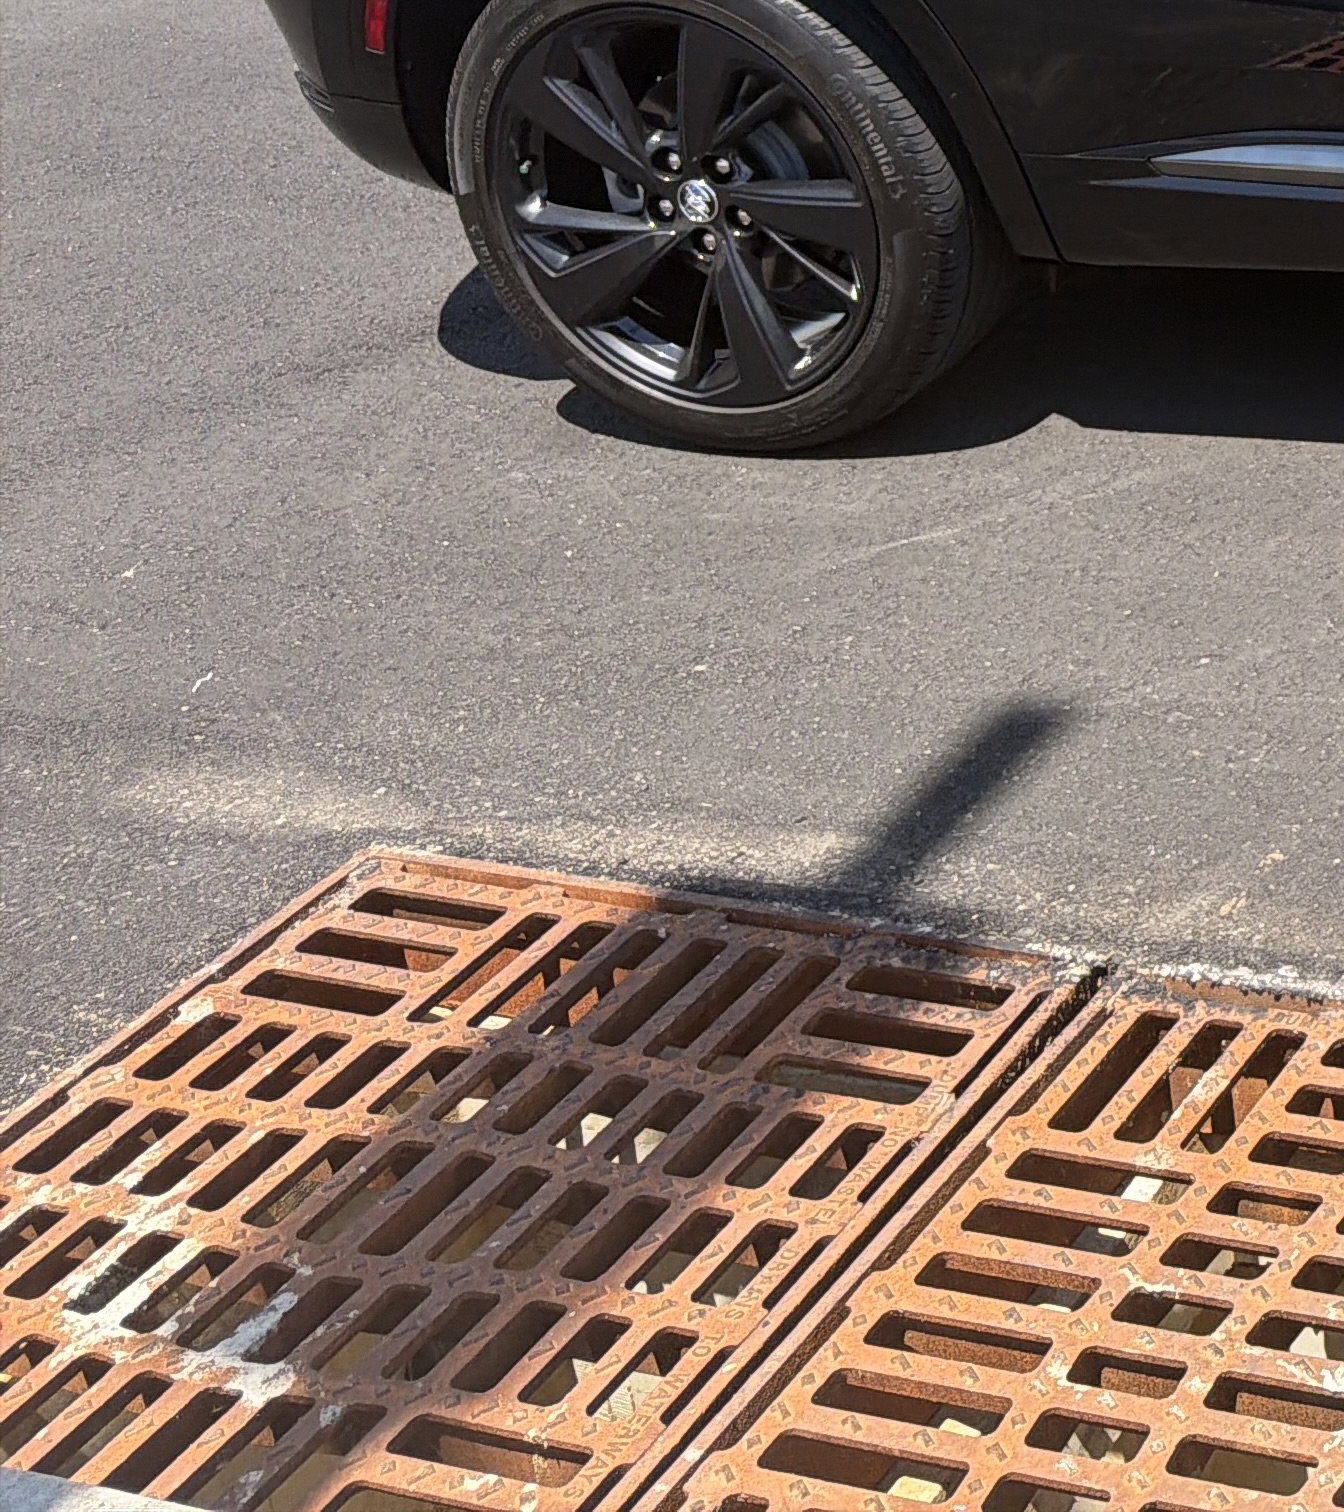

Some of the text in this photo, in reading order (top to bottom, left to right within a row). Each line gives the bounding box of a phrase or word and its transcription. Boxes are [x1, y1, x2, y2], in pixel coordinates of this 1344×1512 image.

[831, 73, 904, 184] Continental
[882, 1126, 911, 1149] NO
[725, 1247, 800, 1321] DRAINS
[691, 1333, 725, 1358] TO
[562, 1372, 690, 1500] WATERWAYS
